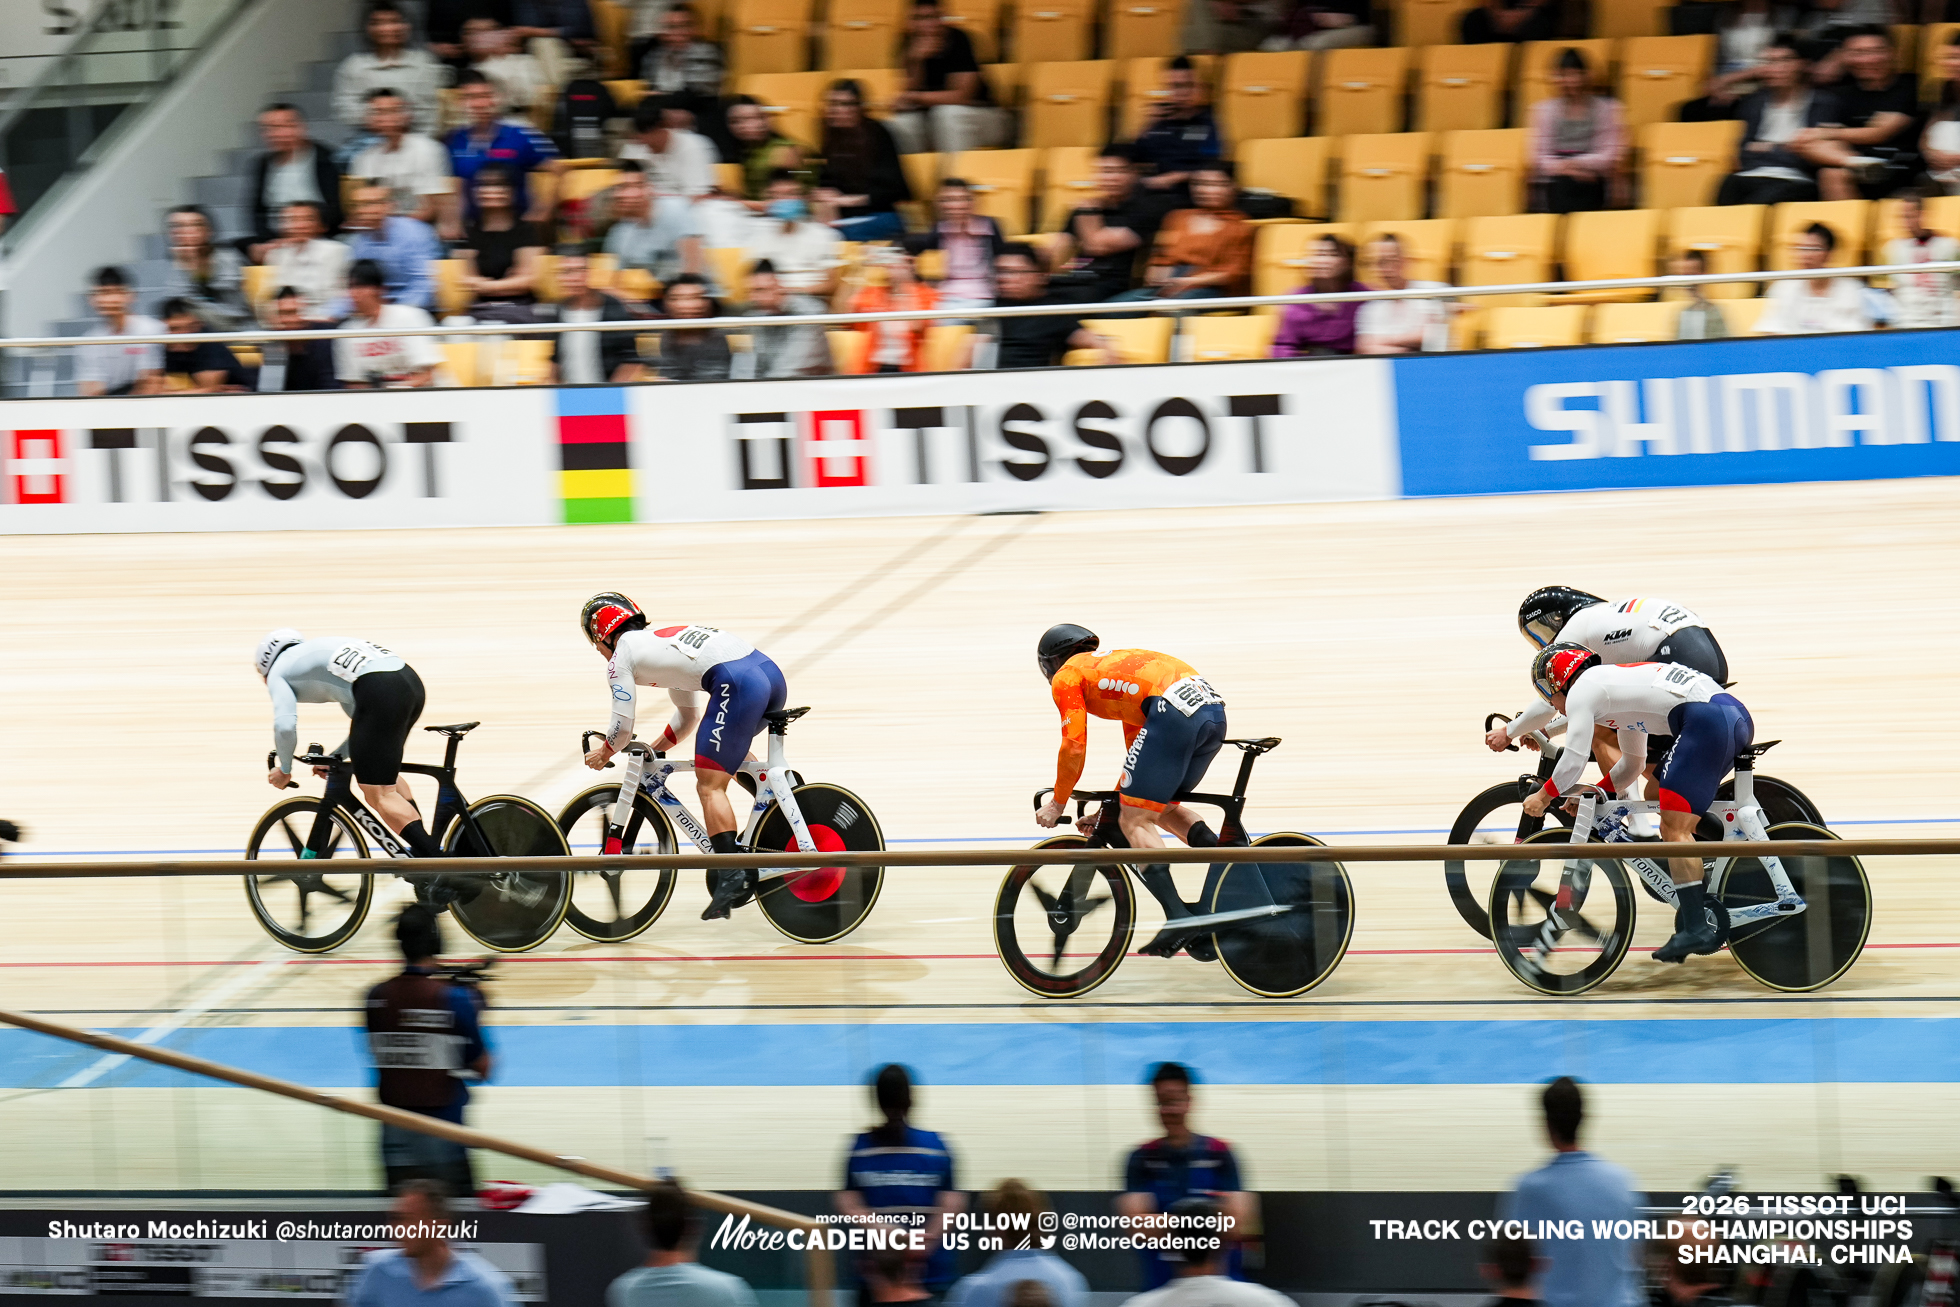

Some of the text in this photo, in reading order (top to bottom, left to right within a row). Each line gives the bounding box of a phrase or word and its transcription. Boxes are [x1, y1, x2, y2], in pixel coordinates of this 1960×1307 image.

[889, 394, 1285, 484] TISSOT
[86, 422, 458, 502] TISSOT
[604, 609, 634, 633] JAPAN
[1525, 609, 1542, 620] CASCO
[1603, 628, 1632, 641] KTM
[333, 647, 367, 673] 201
[1563, 651, 1585, 678] JAPAN
[709, 683, 730, 752] JAPAN
[1662, 734, 1682, 779] JAPAN
[353, 808, 410, 858] KOG
